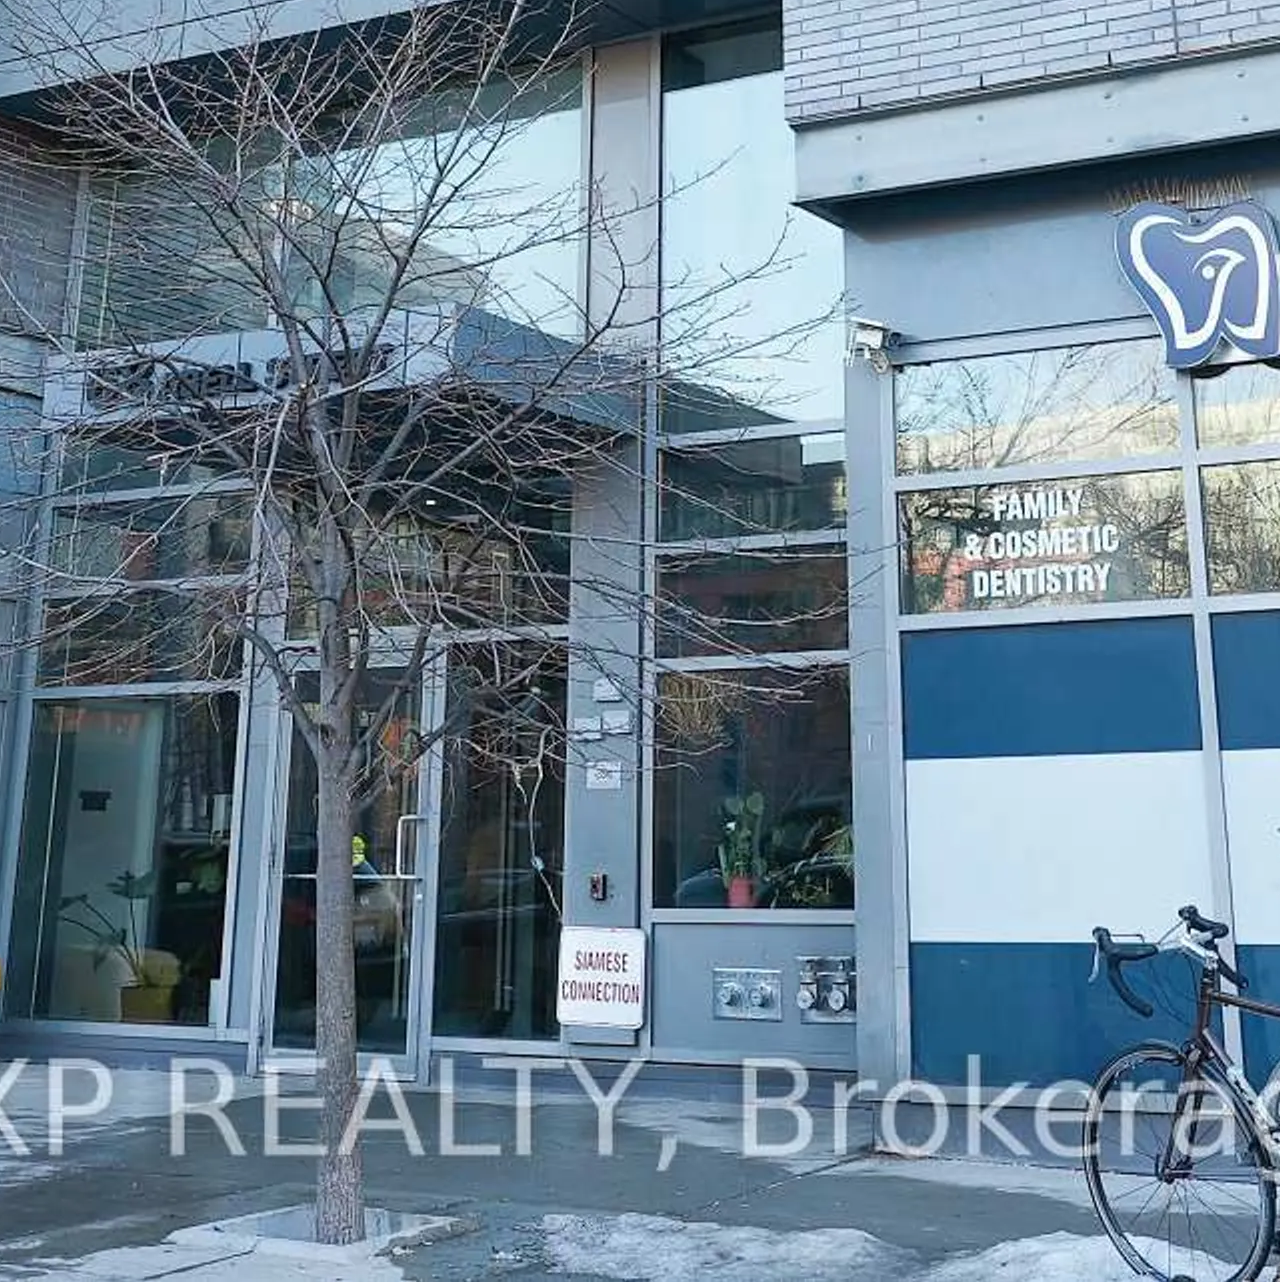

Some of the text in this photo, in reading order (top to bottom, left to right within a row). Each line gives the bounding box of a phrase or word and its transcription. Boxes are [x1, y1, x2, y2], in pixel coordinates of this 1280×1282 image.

[994, 488, 1083, 521] FAMILY
[963, 523, 1120, 560] & COSMETIC
[973, 562, 1111, 598] DENTISTRY
[574, 950, 629, 973] SIAMESE
[561, 979, 640, 1004] CONNECTION
